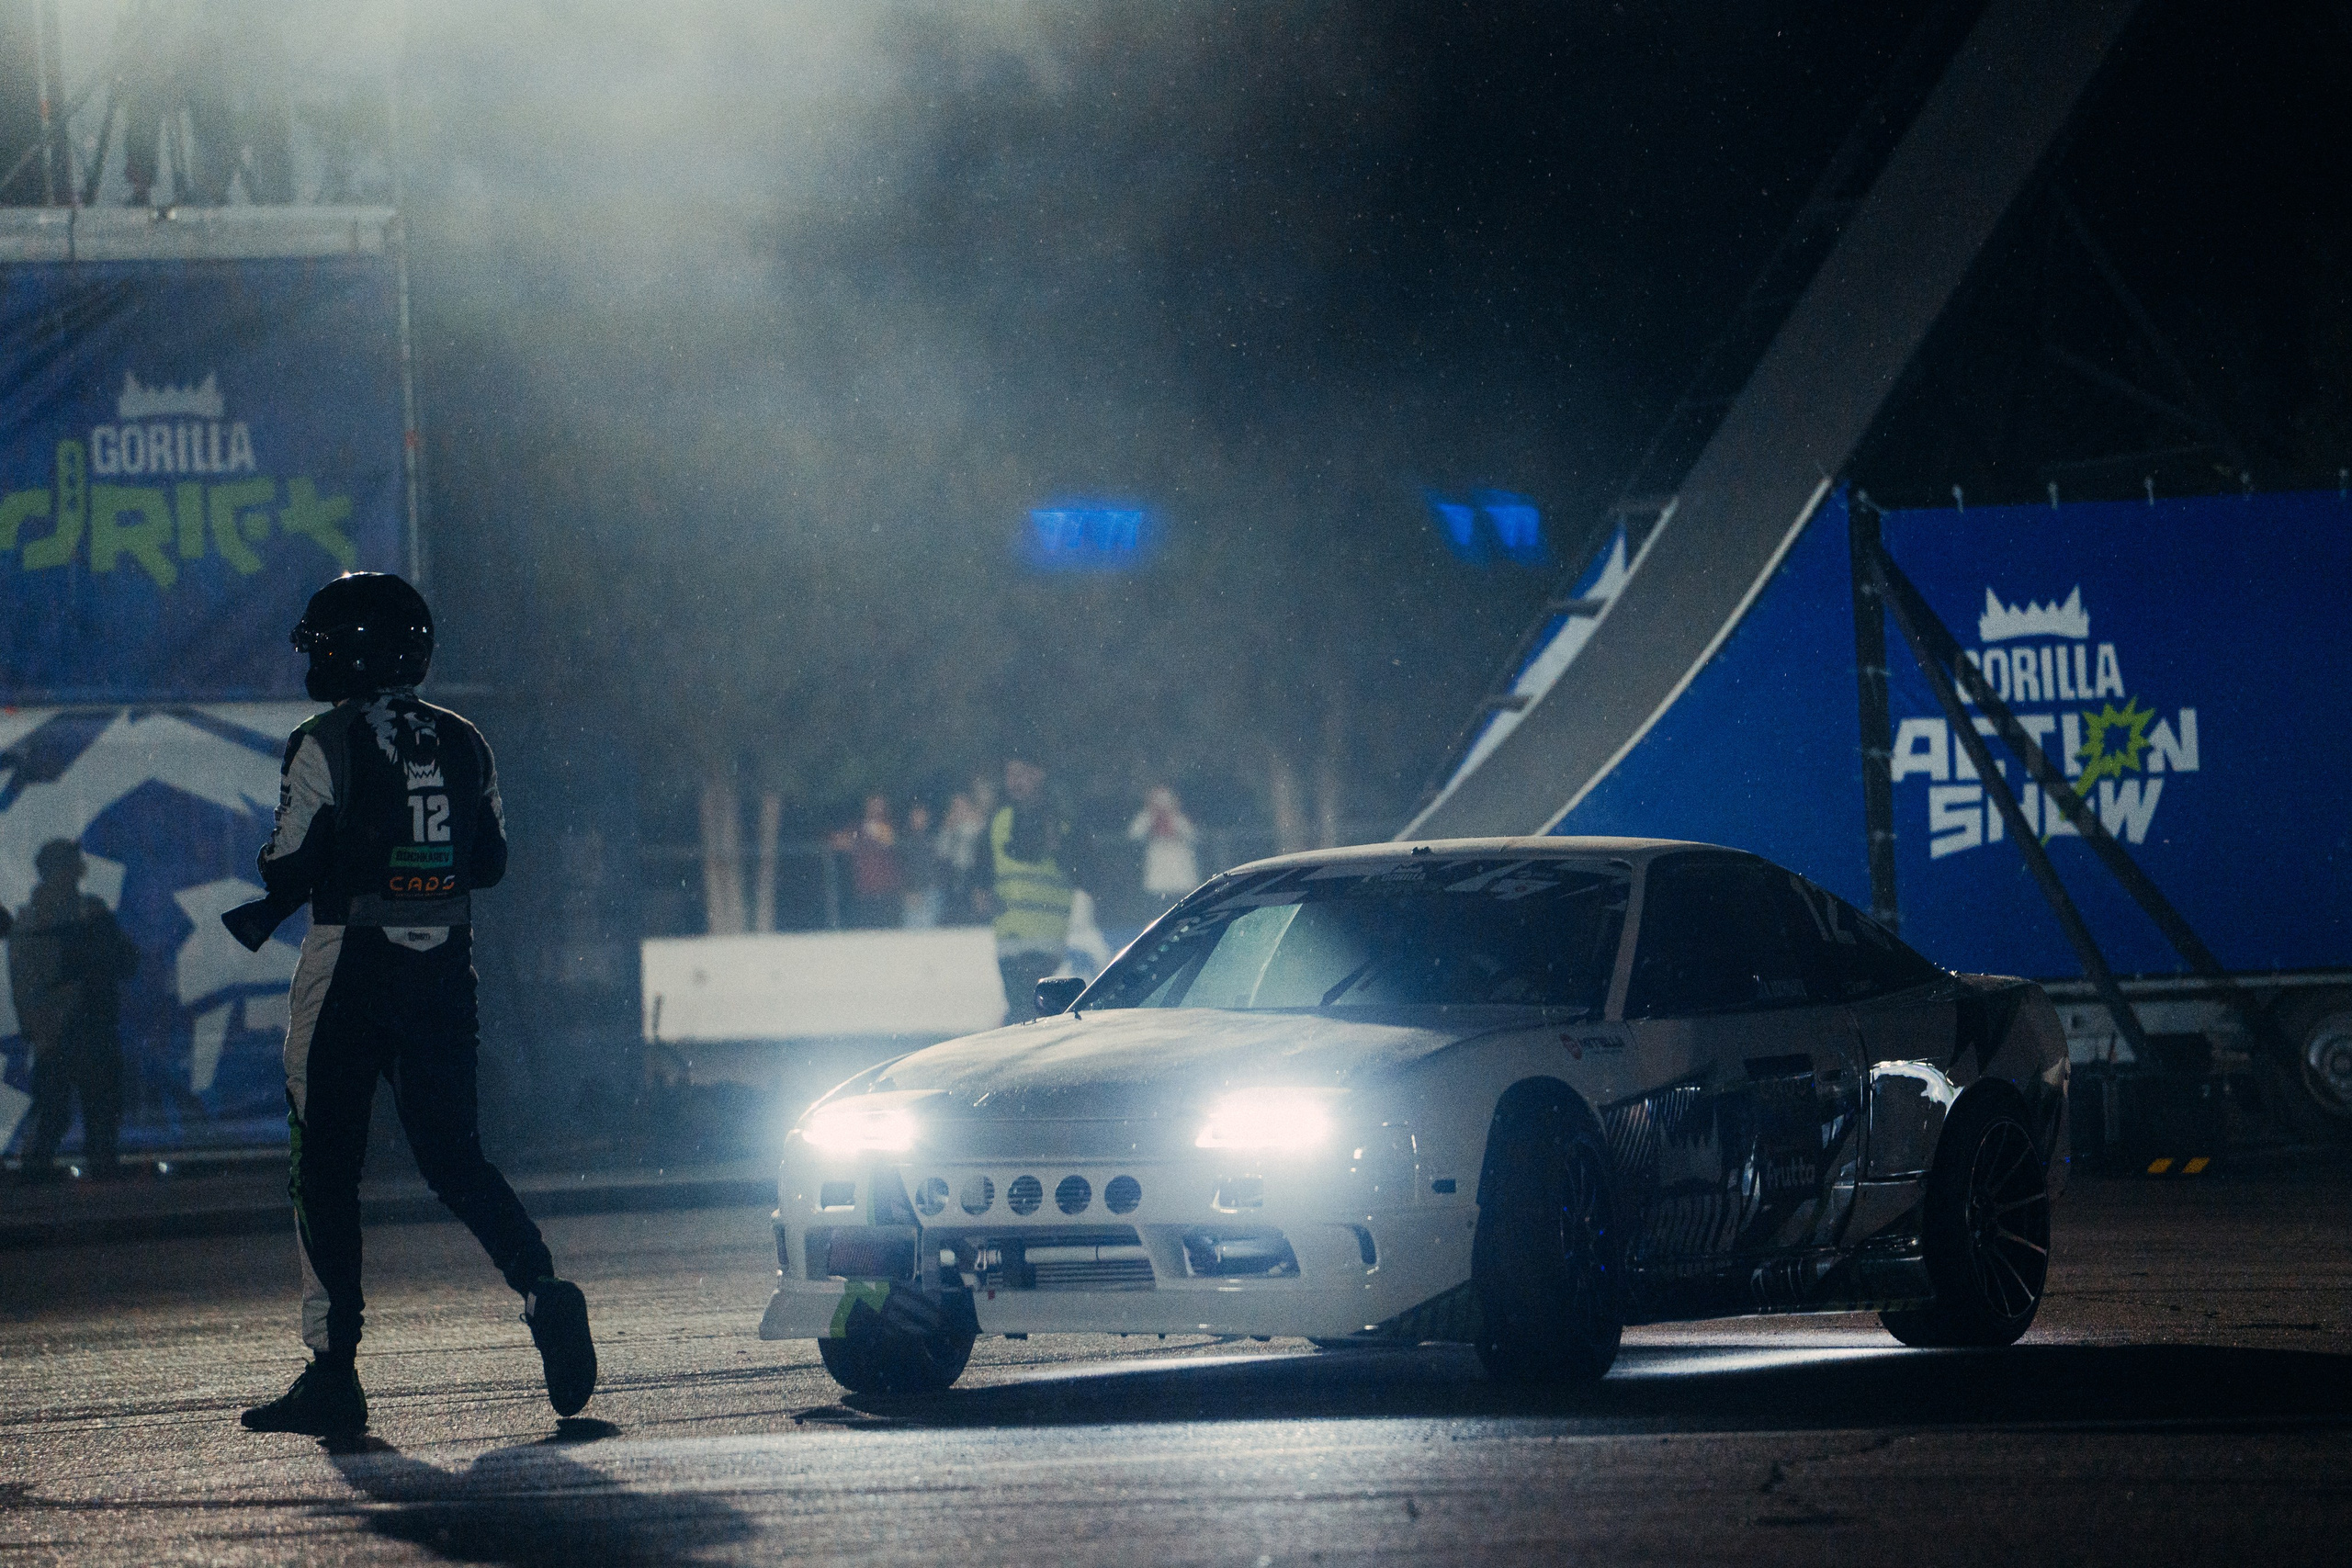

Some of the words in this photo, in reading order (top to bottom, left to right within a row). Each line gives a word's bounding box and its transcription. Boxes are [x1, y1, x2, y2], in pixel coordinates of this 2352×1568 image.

[94, 422, 257, 475] GORILLA
[1954, 642, 2126, 705] GORILLA
[407, 795, 451, 843] 12
